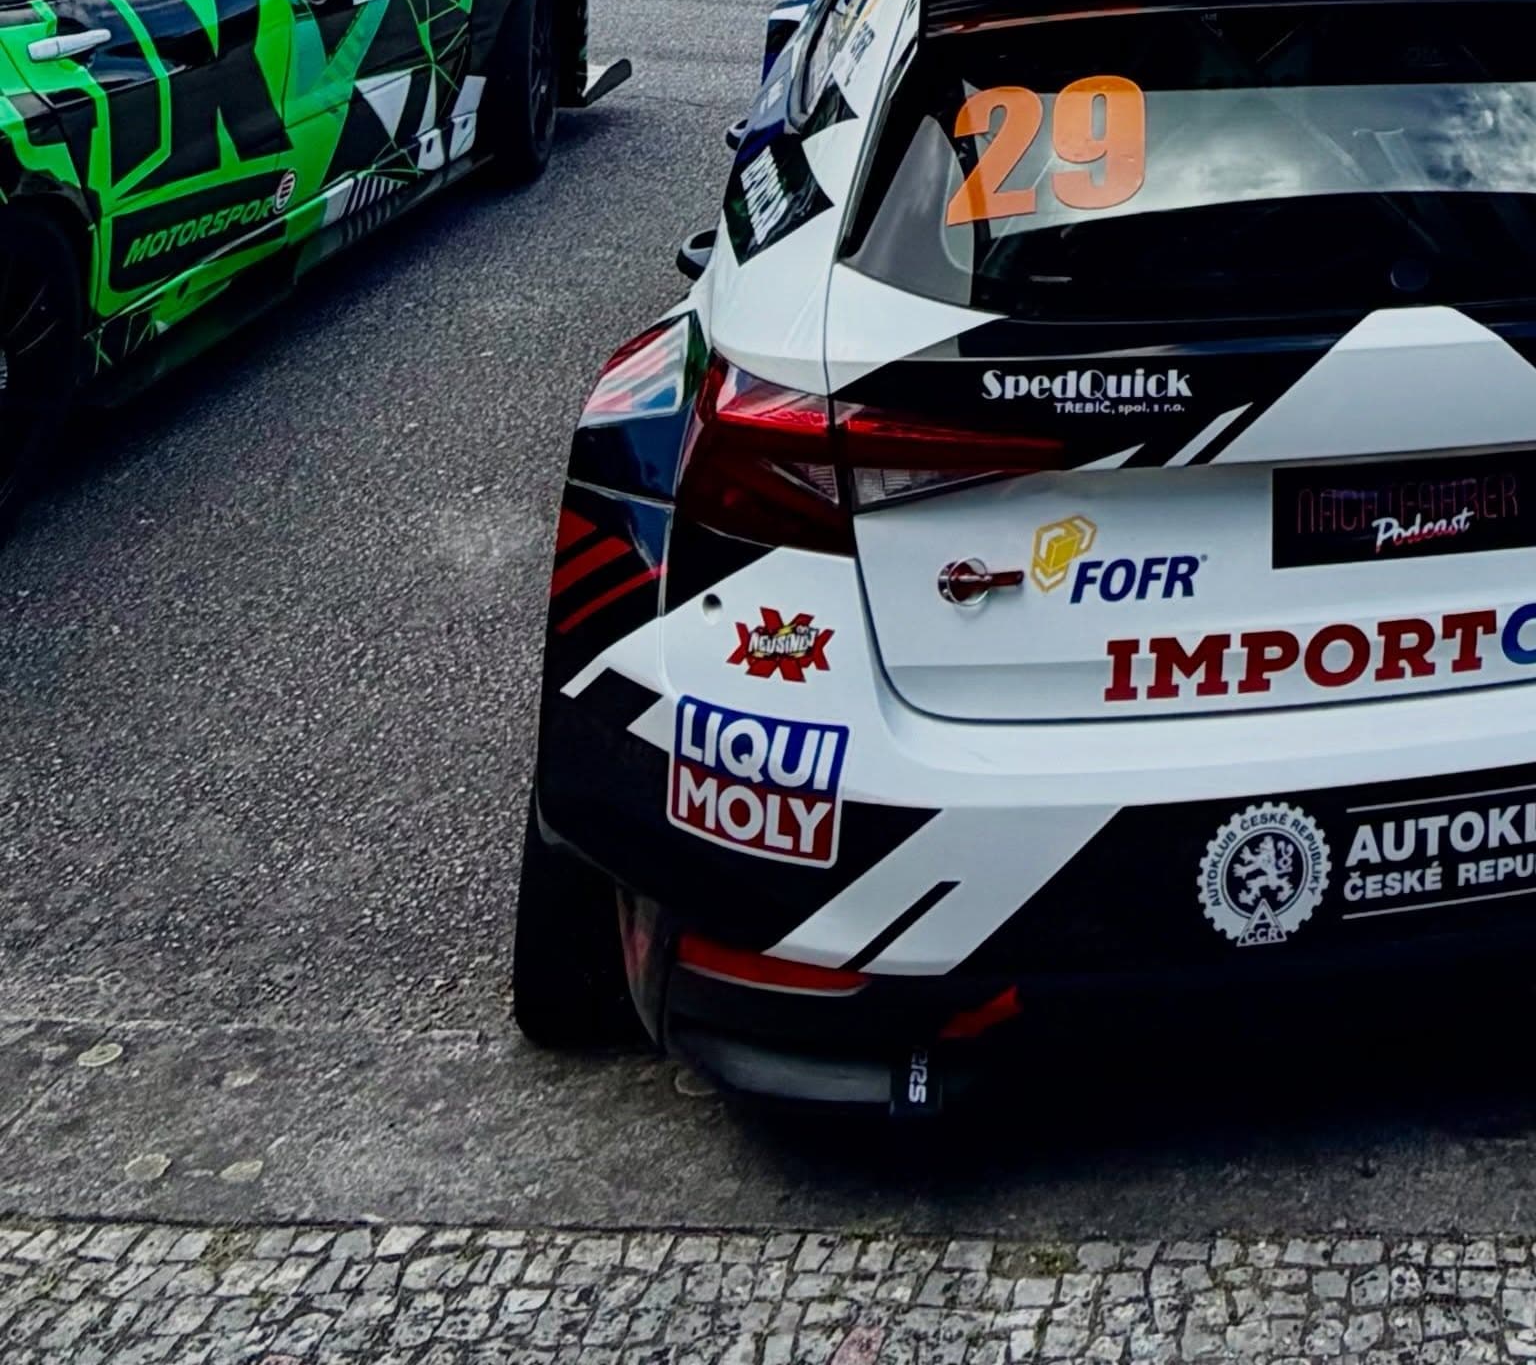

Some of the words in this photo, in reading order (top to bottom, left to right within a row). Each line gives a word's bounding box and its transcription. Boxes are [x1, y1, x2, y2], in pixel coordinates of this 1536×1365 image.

[947, 75, 1146, 226] 29
[122, 193, 279, 268] MOTORSPOR
[981, 368, 1193, 400] SpedQuick
[1371, 506, 1475, 554] Podcast
[1070, 554, 1200, 605] FOFR
[680, 702, 841, 791] LIQUI
[678, 766, 834, 856] MOLY
[1206, 830, 1237, 907] AUTOKLUB
[1240, 812, 1290, 831] ČESKÉ
[1290, 818, 1323, 896] REPUBLIKY
[1344, 857, 1444, 902] ČESKÉ
